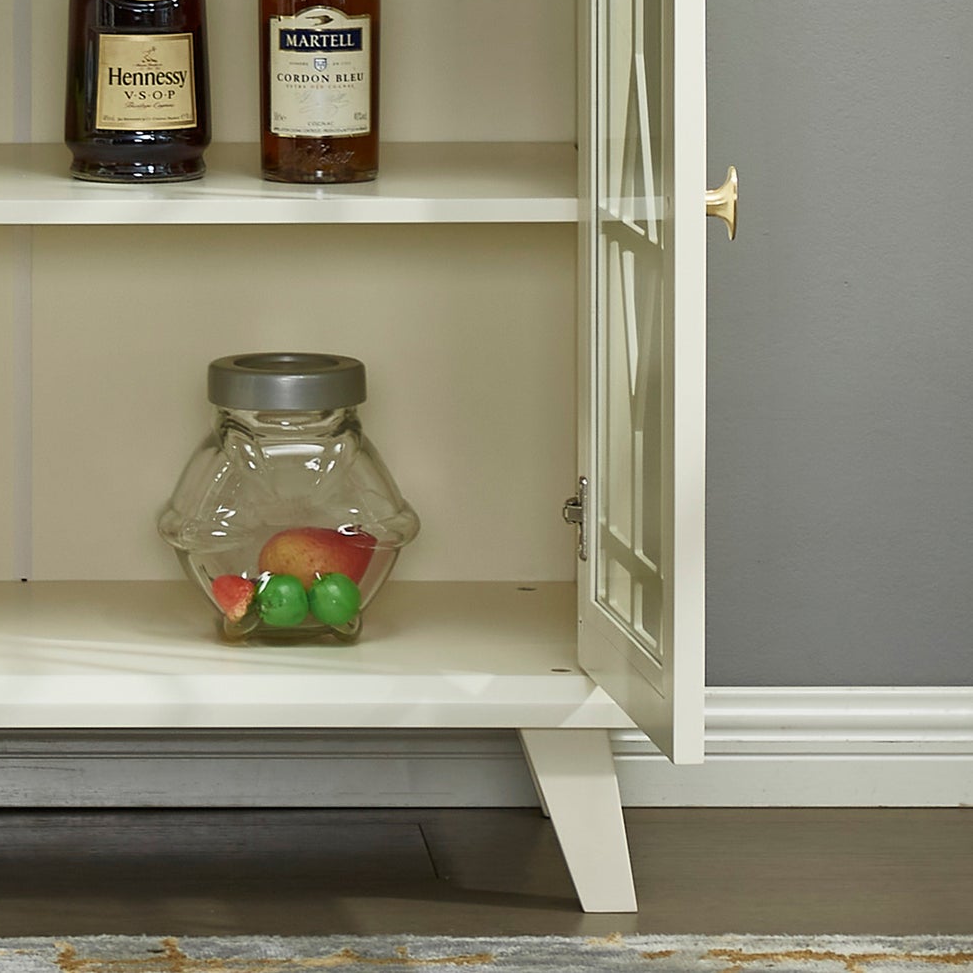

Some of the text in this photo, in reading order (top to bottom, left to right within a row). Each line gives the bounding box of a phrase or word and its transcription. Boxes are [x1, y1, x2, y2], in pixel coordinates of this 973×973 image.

[285, 33, 356, 48] MARTELL
[108, 67, 188, 88] Hennessy
[276, 72, 364, 83] CORDON BLEU
